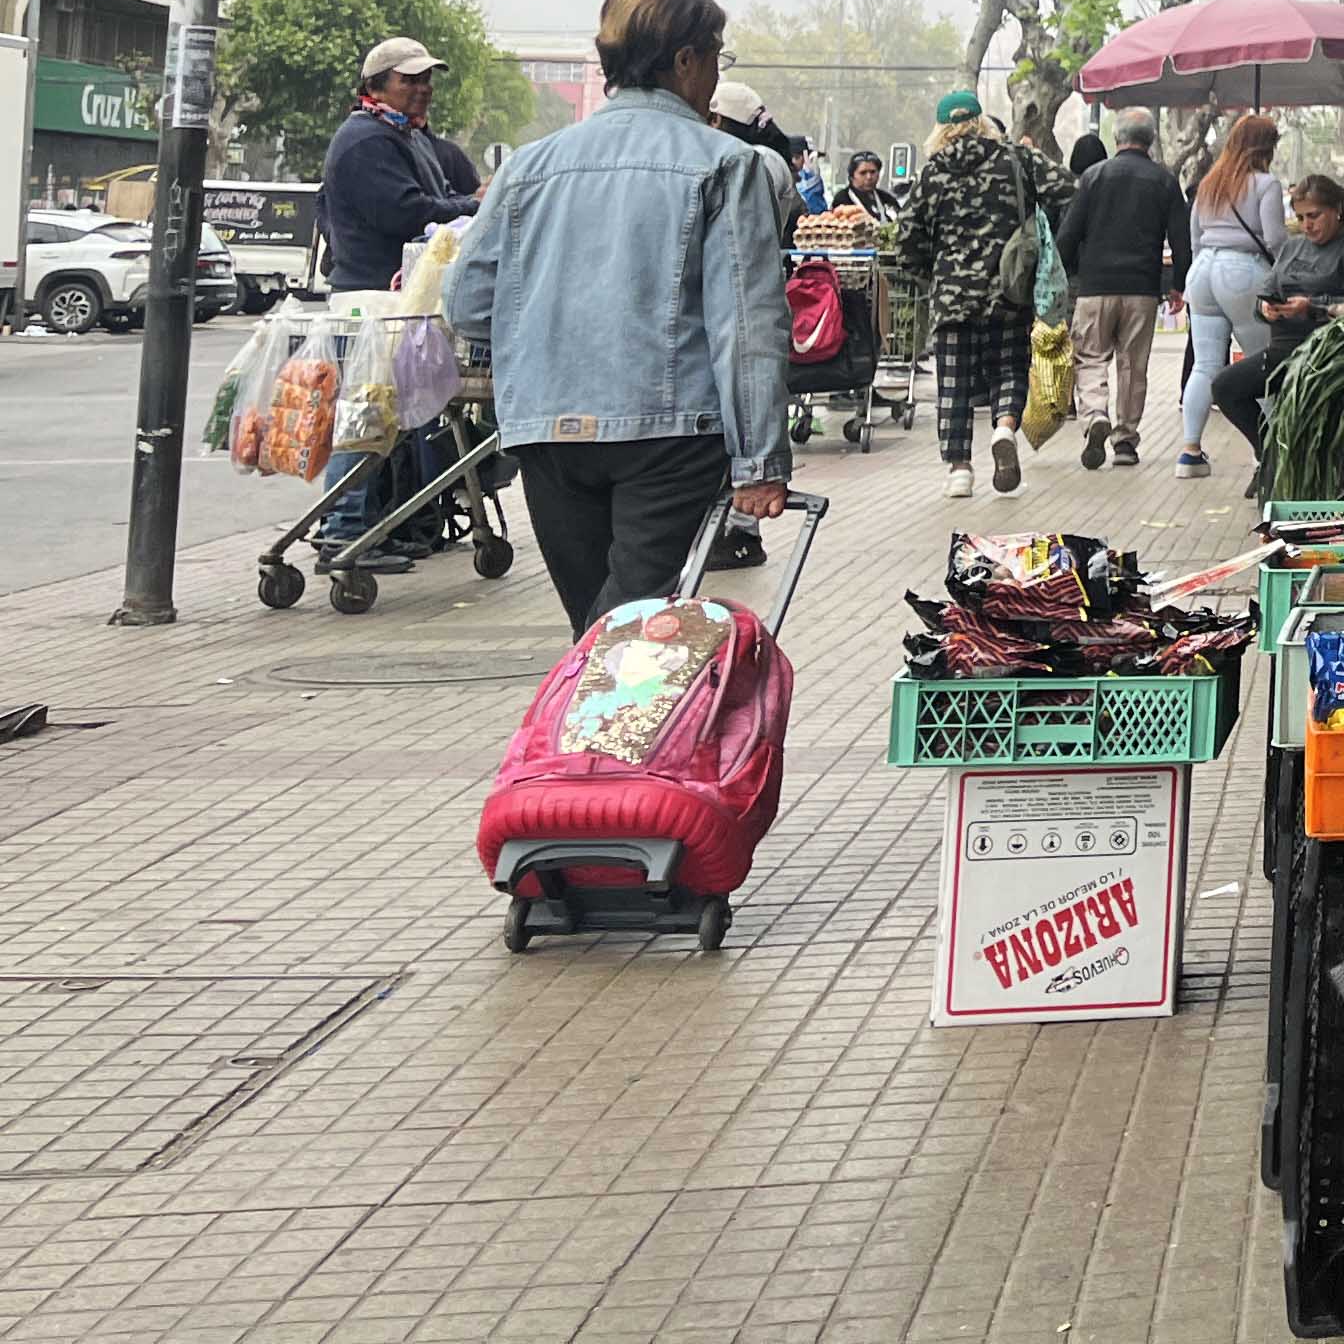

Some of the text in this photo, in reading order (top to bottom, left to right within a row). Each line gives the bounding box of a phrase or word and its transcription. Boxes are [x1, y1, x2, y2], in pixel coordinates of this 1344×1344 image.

[81, 84, 123, 129] Cruz
[1098, 870, 1116, 885] LO
[1057, 878, 1097, 905] MEJOR
[1022, 909, 1039, 922] LA
[1040, 899, 1056, 913] DE
[982, 876, 1140, 990] ARIZONA
[987, 916, 1020, 938] ZONA
[1073, 951, 1118, 986] HUEVOS
